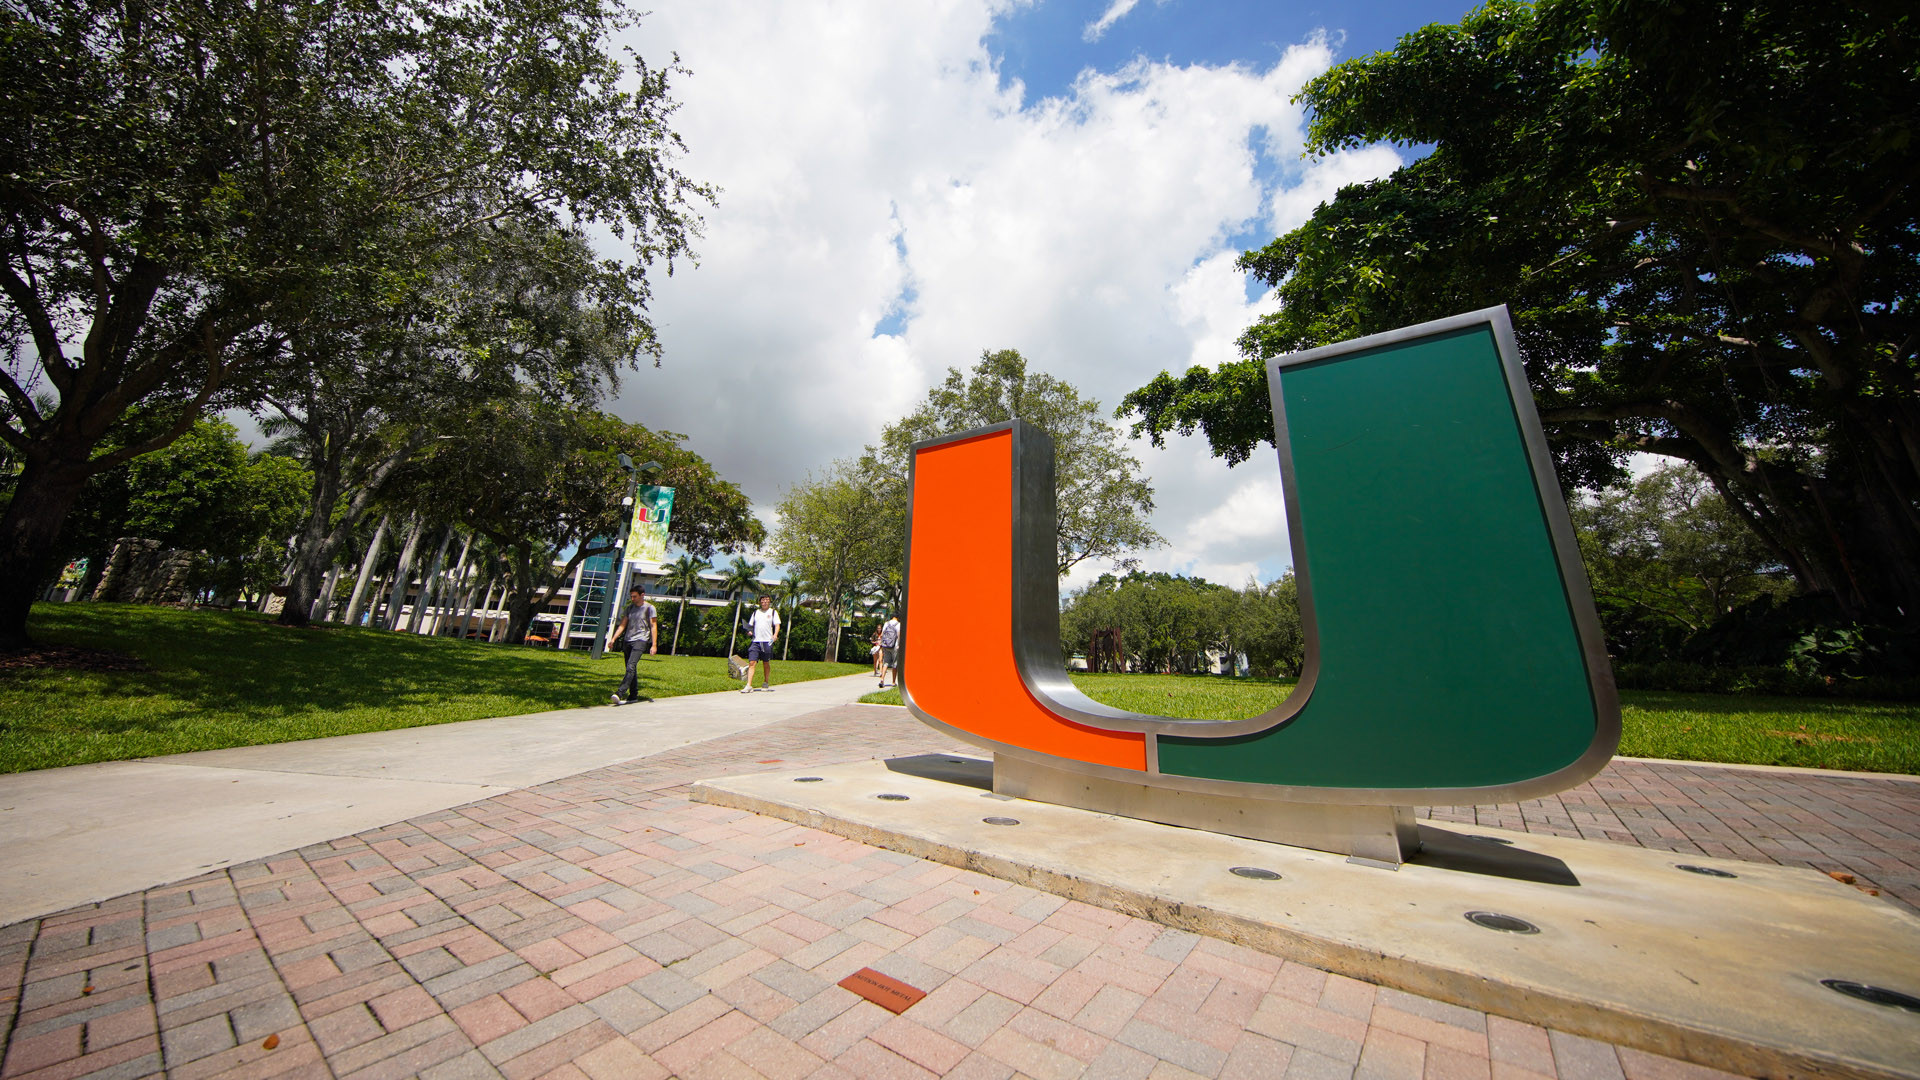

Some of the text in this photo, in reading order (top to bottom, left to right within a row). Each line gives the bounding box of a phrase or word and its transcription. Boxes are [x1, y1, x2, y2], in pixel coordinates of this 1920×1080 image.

[638, 507, 666, 523] U
[902, 304, 1622, 805] U
[877, 984, 891, 992] HOT
[891, 989, 912, 1001] METAL
